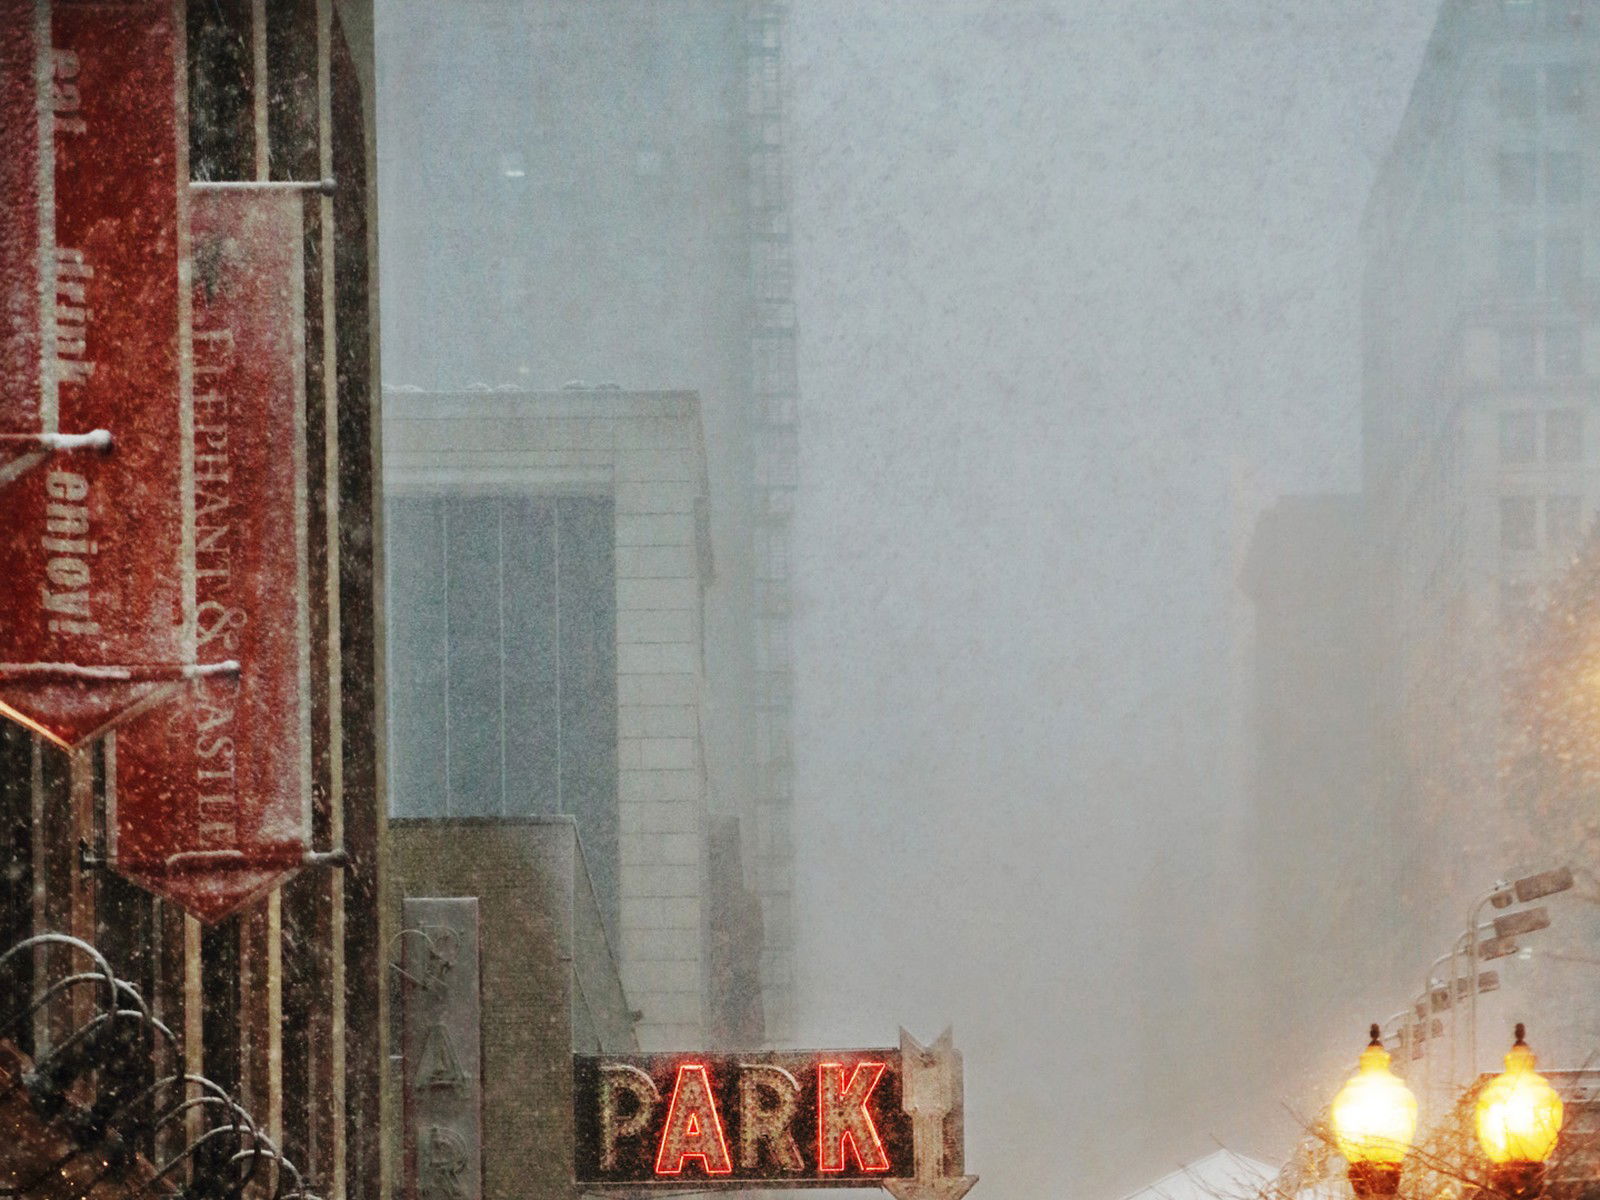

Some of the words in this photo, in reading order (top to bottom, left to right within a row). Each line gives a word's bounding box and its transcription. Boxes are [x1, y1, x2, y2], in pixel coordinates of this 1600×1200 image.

[57, 247, 95, 386] drink
[42, 470, 100, 635] enjoy!
[196, 602, 247, 652] &
[600, 1062, 889, 1174] PARK
